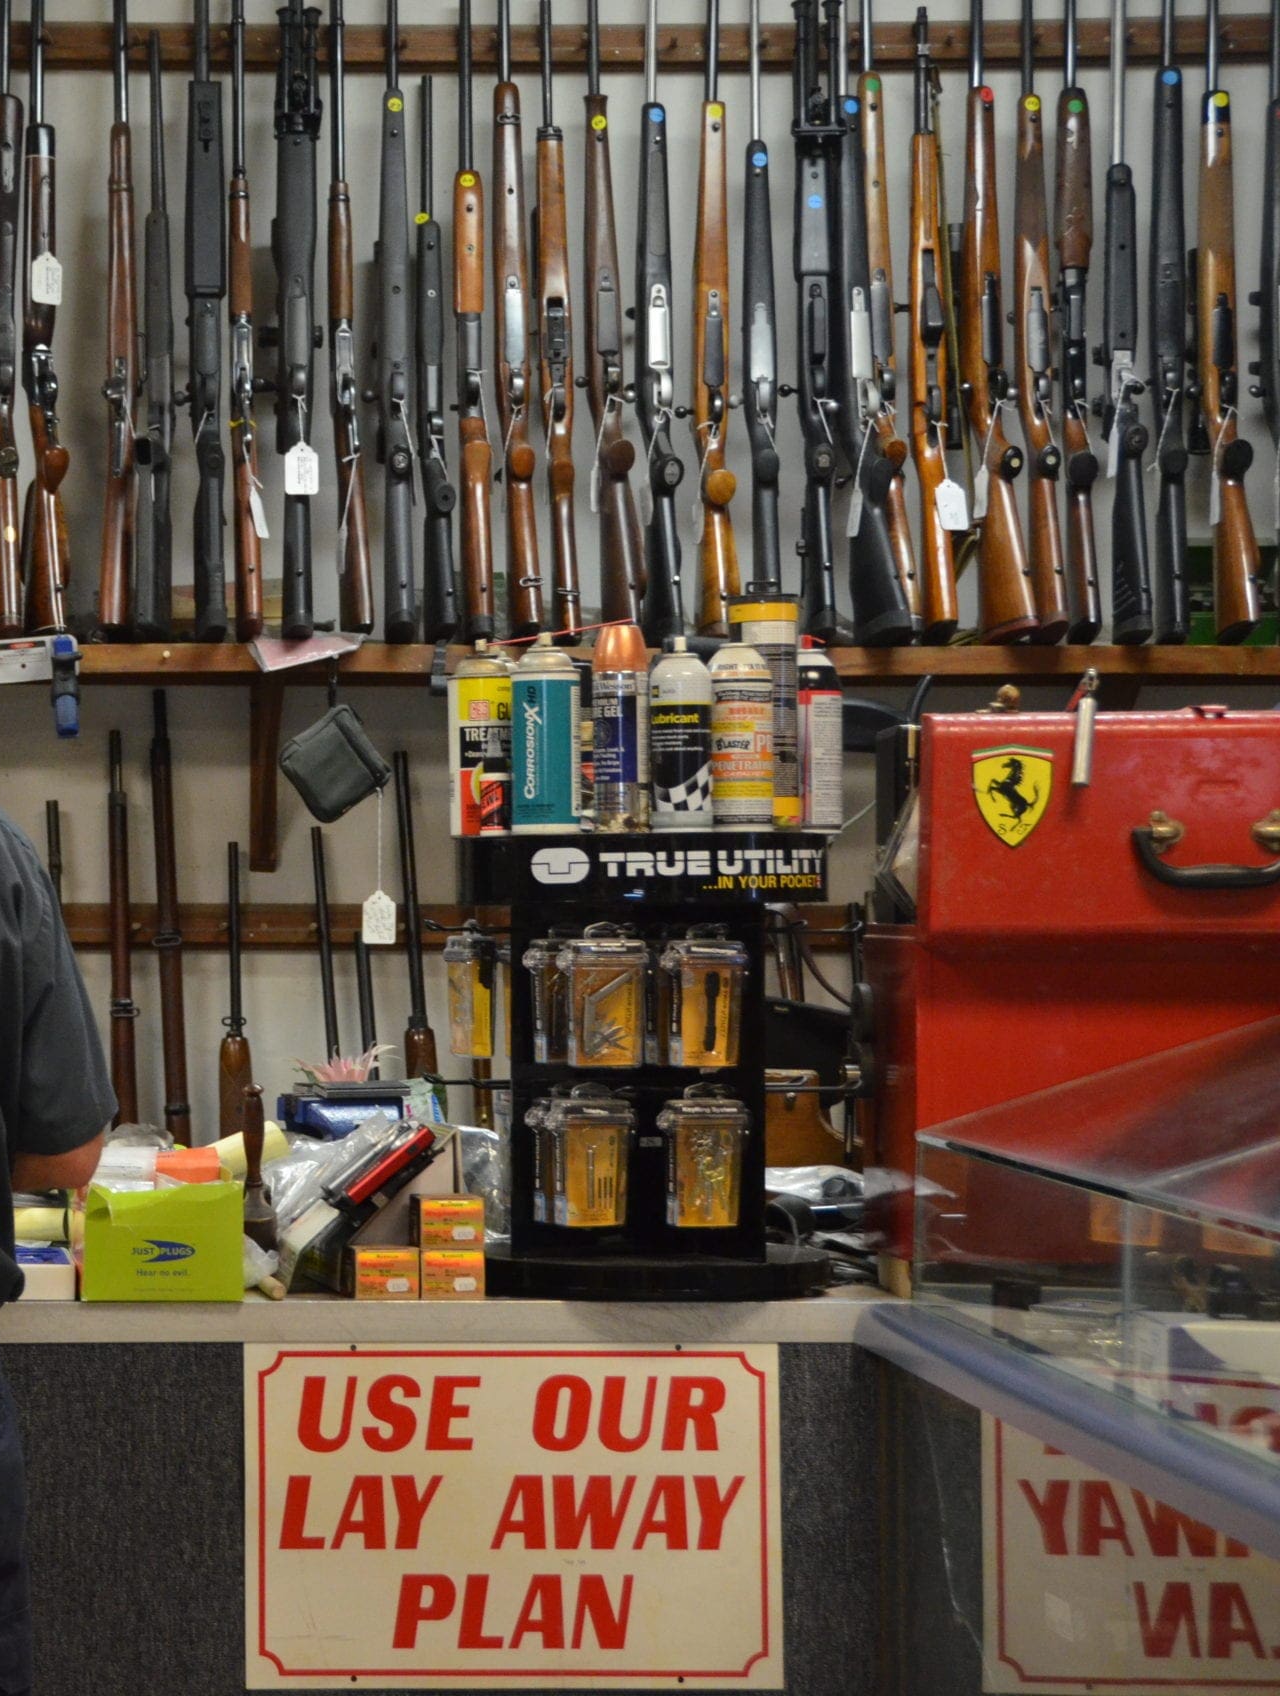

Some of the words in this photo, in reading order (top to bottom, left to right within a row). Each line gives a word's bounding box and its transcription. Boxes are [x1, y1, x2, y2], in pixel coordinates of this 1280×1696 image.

[599, 851, 711, 877] TRUE
[717, 849, 821, 875] UTILITY
[738, 875, 777, 889] YOUR
[131, 1247, 154, 1255] JUST
[160, 1247, 193, 1255] PLUGS
[136, 1268, 155, 1276] Hear
[297, 1375, 481, 1453] USE
[532, 1375, 726, 1453] OUR
[278, 1475, 443, 1550] LAY
[490, 1475, 745, 1550] AWAY
[392, 1574, 634, 1649] PLAN
